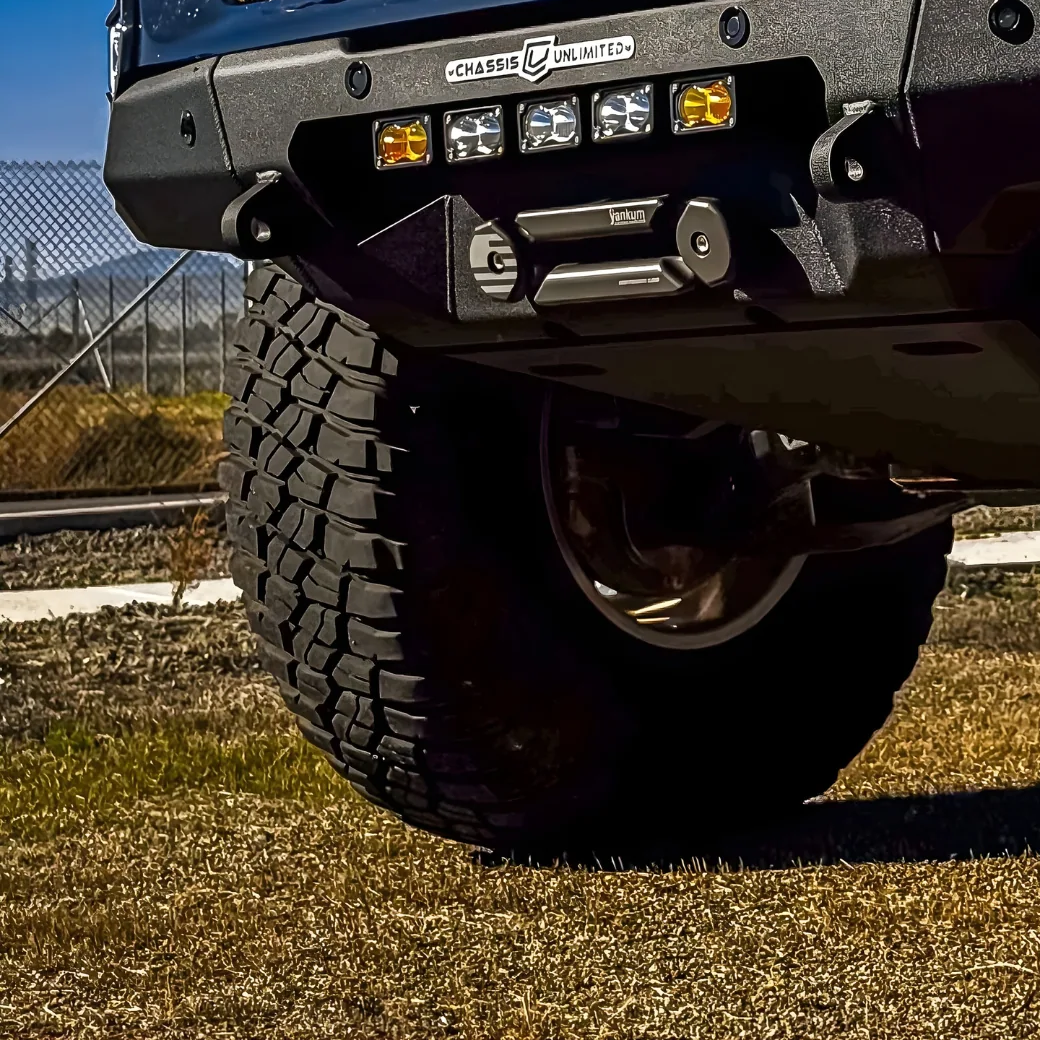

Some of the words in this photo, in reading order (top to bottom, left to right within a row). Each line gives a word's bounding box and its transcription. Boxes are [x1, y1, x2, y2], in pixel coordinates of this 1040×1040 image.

[456, 56, 519, 77] CHASSIS
[554, 42, 623, 64] UNLIMITED
[609, 208, 646, 225] Yankum
